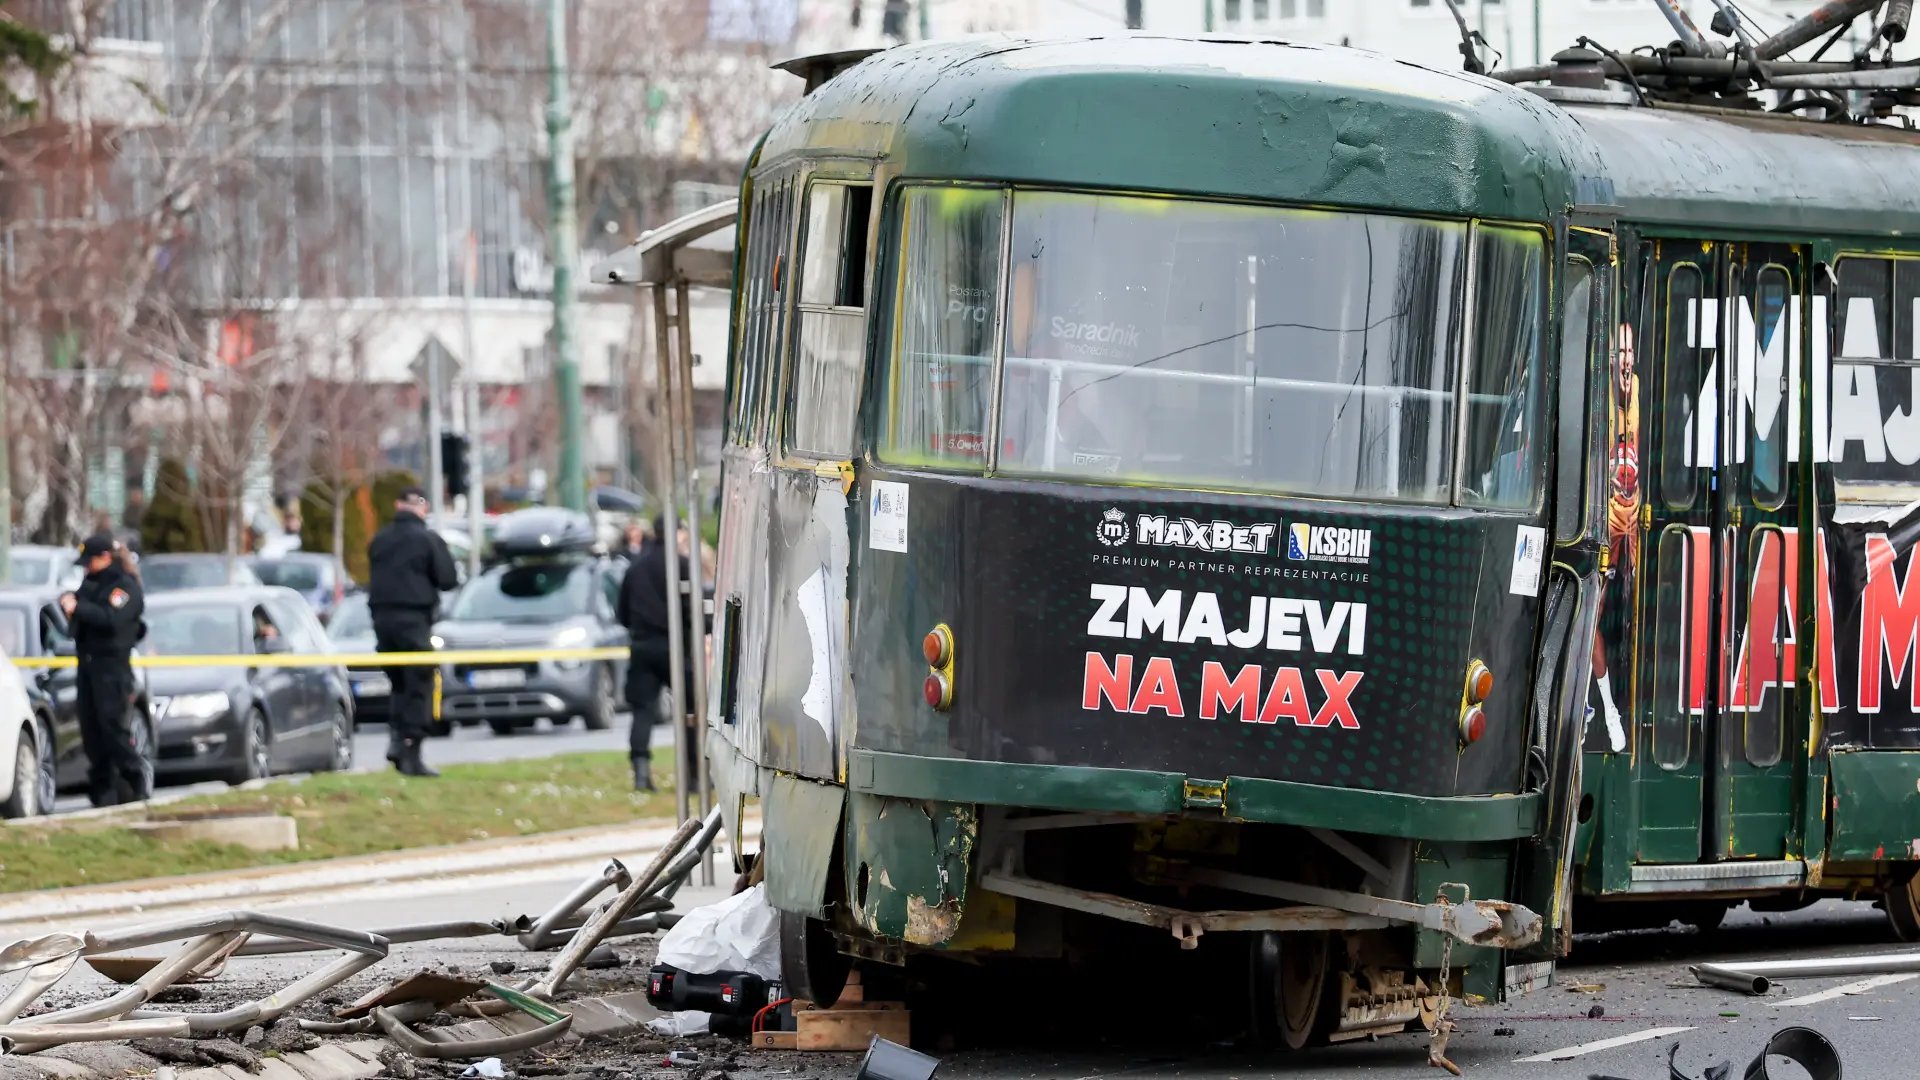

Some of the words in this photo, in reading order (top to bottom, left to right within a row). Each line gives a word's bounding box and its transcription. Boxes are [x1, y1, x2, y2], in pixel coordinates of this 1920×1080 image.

[945, 300, 986, 323] Pro
[1050, 316, 1140, 348] Saradnik
[1309, 526, 1372, 557] KSBIH
[1092, 554, 1160, 568] PREMIUM
[1168, 560, 1235, 574] PARTNER
[1244, 566, 1369, 583] REPREZENTACIJE
[1087, 583, 1367, 655] ZMAJEVI
[1082, 651, 1185, 717] NA
[1199, 661, 1364, 730] MAX
